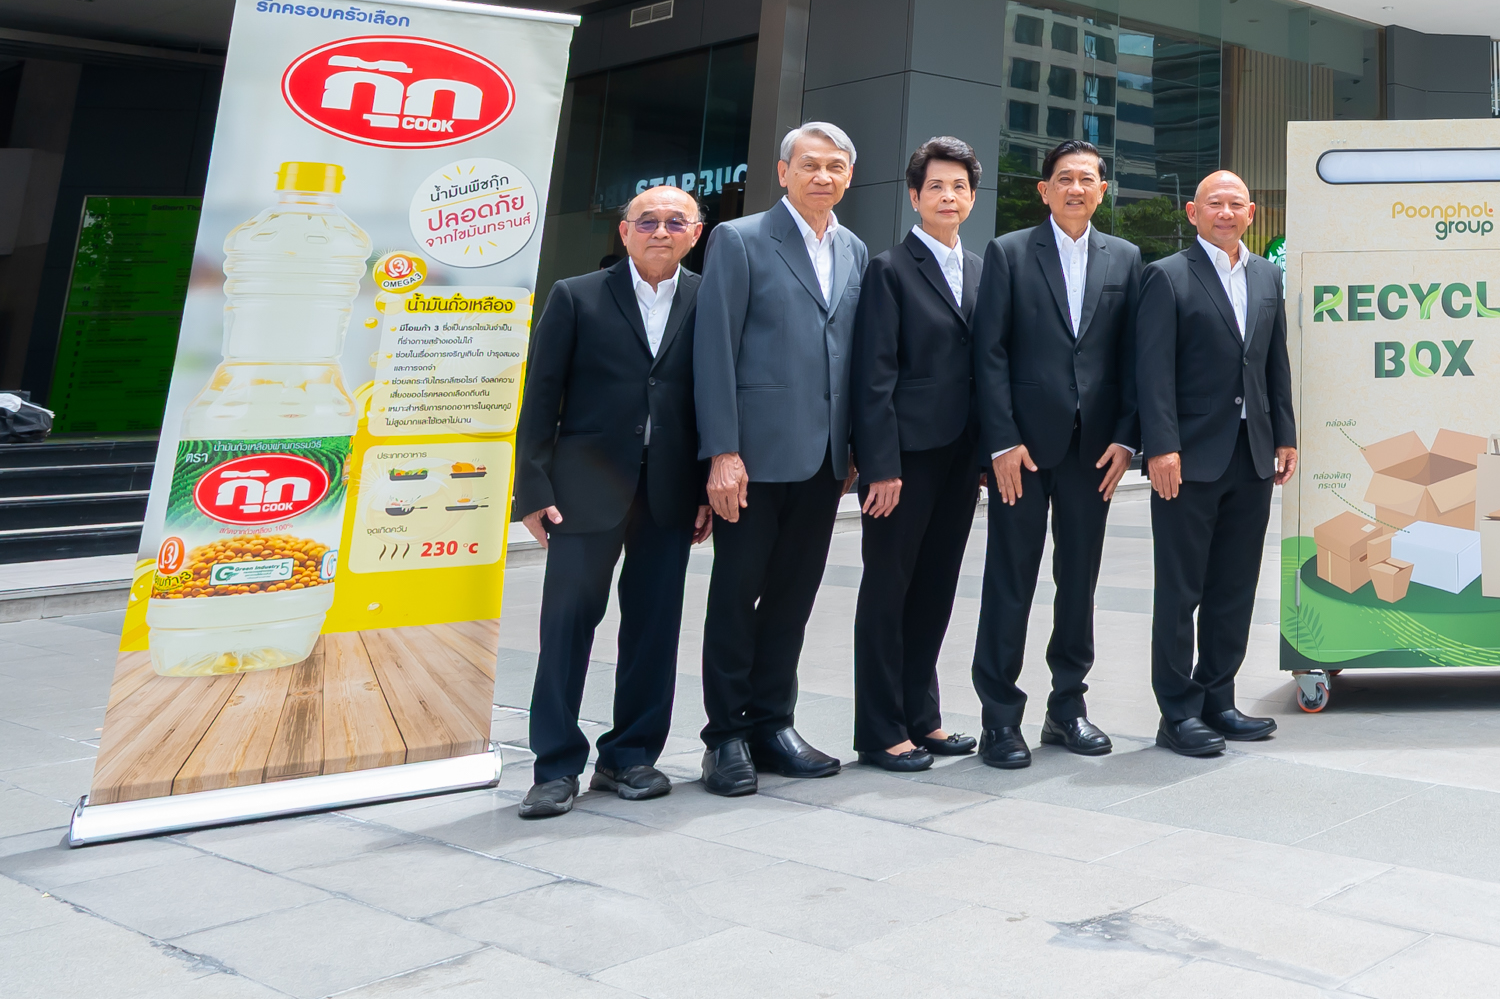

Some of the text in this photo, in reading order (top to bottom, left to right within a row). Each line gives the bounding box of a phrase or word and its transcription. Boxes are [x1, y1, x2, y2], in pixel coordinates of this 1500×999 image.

[401, 115, 455, 133] COOK
[430, 174, 509, 202] น้ำมันพืชกุ๊ก
[428, 194, 524, 232] ปลอดภัย
[425, 212, 531, 248] จากไขมันทรานส์
[1435, 220, 1494, 240] group
[382, 275, 416, 288] OMEGA
[407, 293, 513, 313] น้ำมันถั่วเหลือง
[433, 324, 439, 332] 3
[1374, 339, 1475, 379] BOX
[1325, 418, 1357, 427] กล่องลัง
[213, 439, 322, 452] น้ำมันถั่วเหลืองผ่านกรรมวิธี
[185, 452, 209, 463] ตรา
[1313, 471, 1352, 481] กล่องพัสดุ
[1318, 482, 1347, 490] กระดาษ
[261, 502, 294, 513] COOK
[275, 523, 294, 532] 100%
[420, 540, 459, 558] 230
[181, 570, 192, 580] 3
[279, 562, 290, 576] 5
